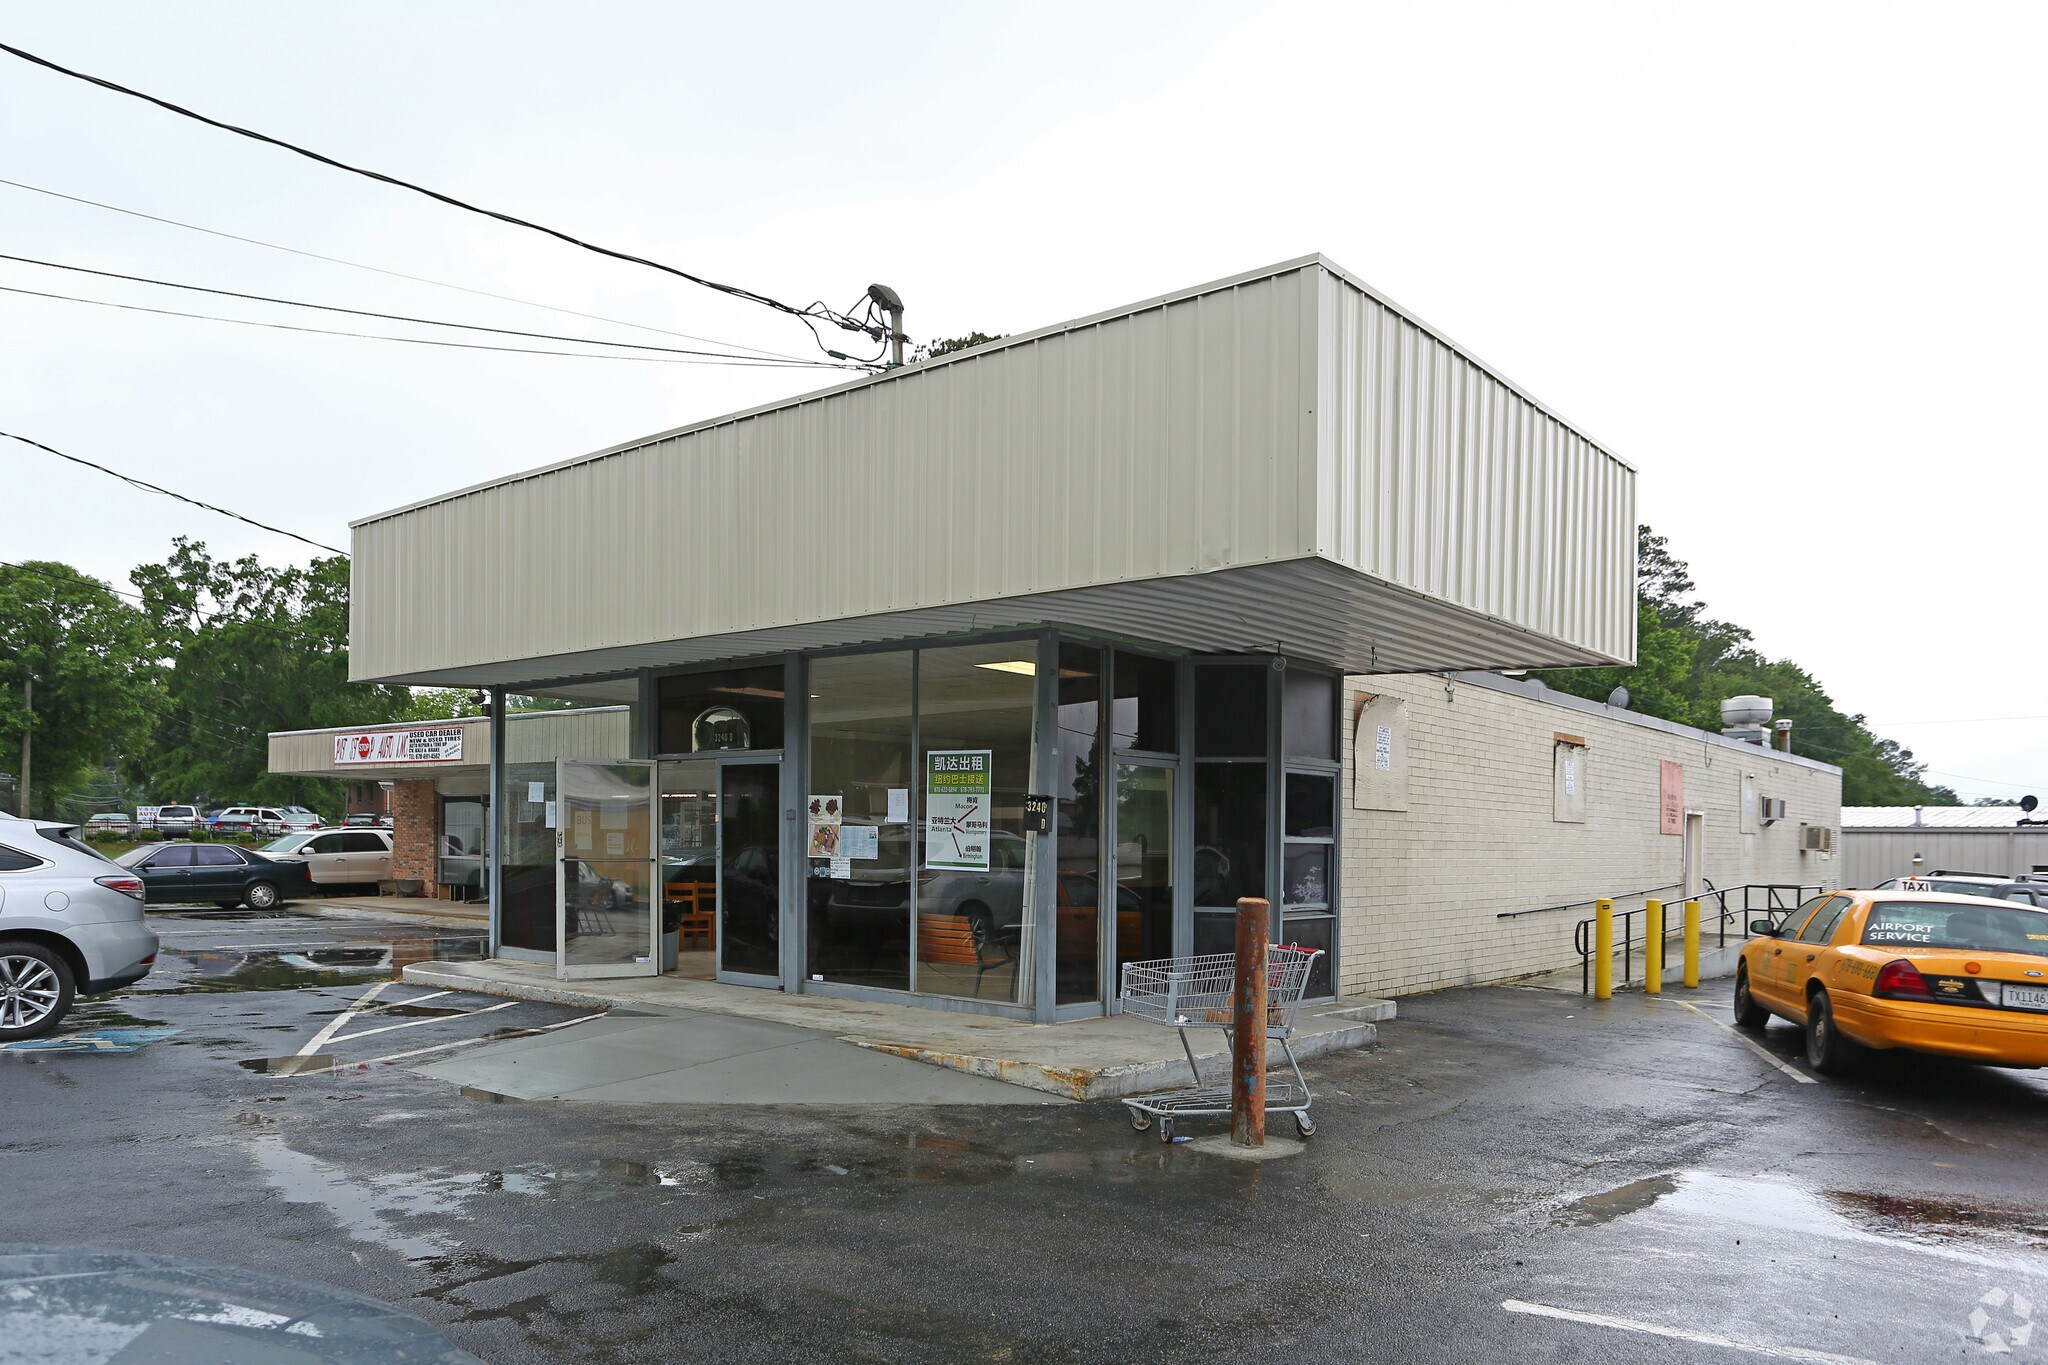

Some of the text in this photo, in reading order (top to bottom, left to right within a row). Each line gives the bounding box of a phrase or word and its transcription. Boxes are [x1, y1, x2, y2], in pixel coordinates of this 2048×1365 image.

[934, 756, 983, 770] 凯达出租
[935, 774, 983, 784] 纽约巴士接送
[577, 815, 592, 825] BUS
[1902, 882, 1928, 891] TAXI
[1868, 923, 1934, 933] AIRPORT
[1870, 932, 1931, 942] SERVICE
[2009, 990, 2048, 1004] TX1146
